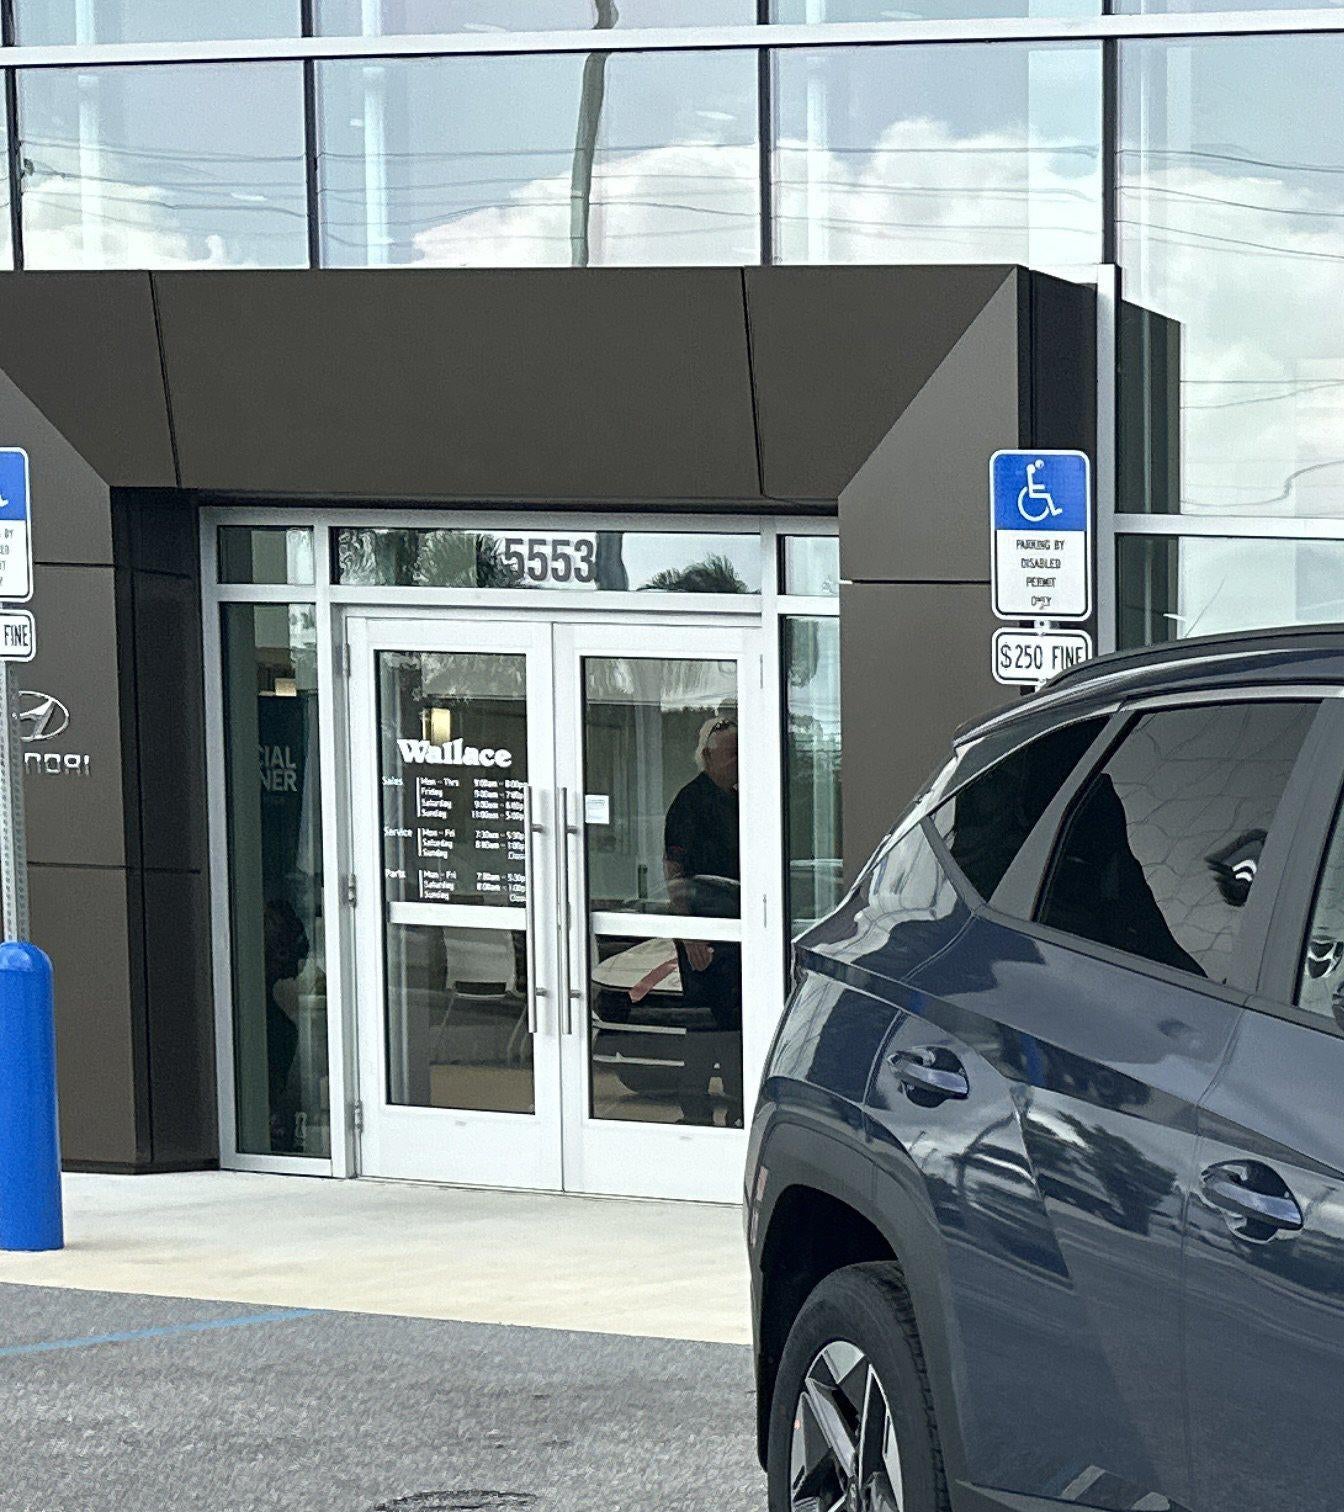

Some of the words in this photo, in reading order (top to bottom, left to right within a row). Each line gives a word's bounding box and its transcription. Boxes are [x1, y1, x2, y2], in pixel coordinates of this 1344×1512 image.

[504, 538, 594, 582] 5553
[1021, 558, 1061, 569] DISABLED
[4, 624, 29, 647] FINE
[1000, 642, 1043, 670] $250
[397, 738, 512, 768] Wallace
[383, 827, 413, 837] Service
[385, 869, 406, 879] Parts
